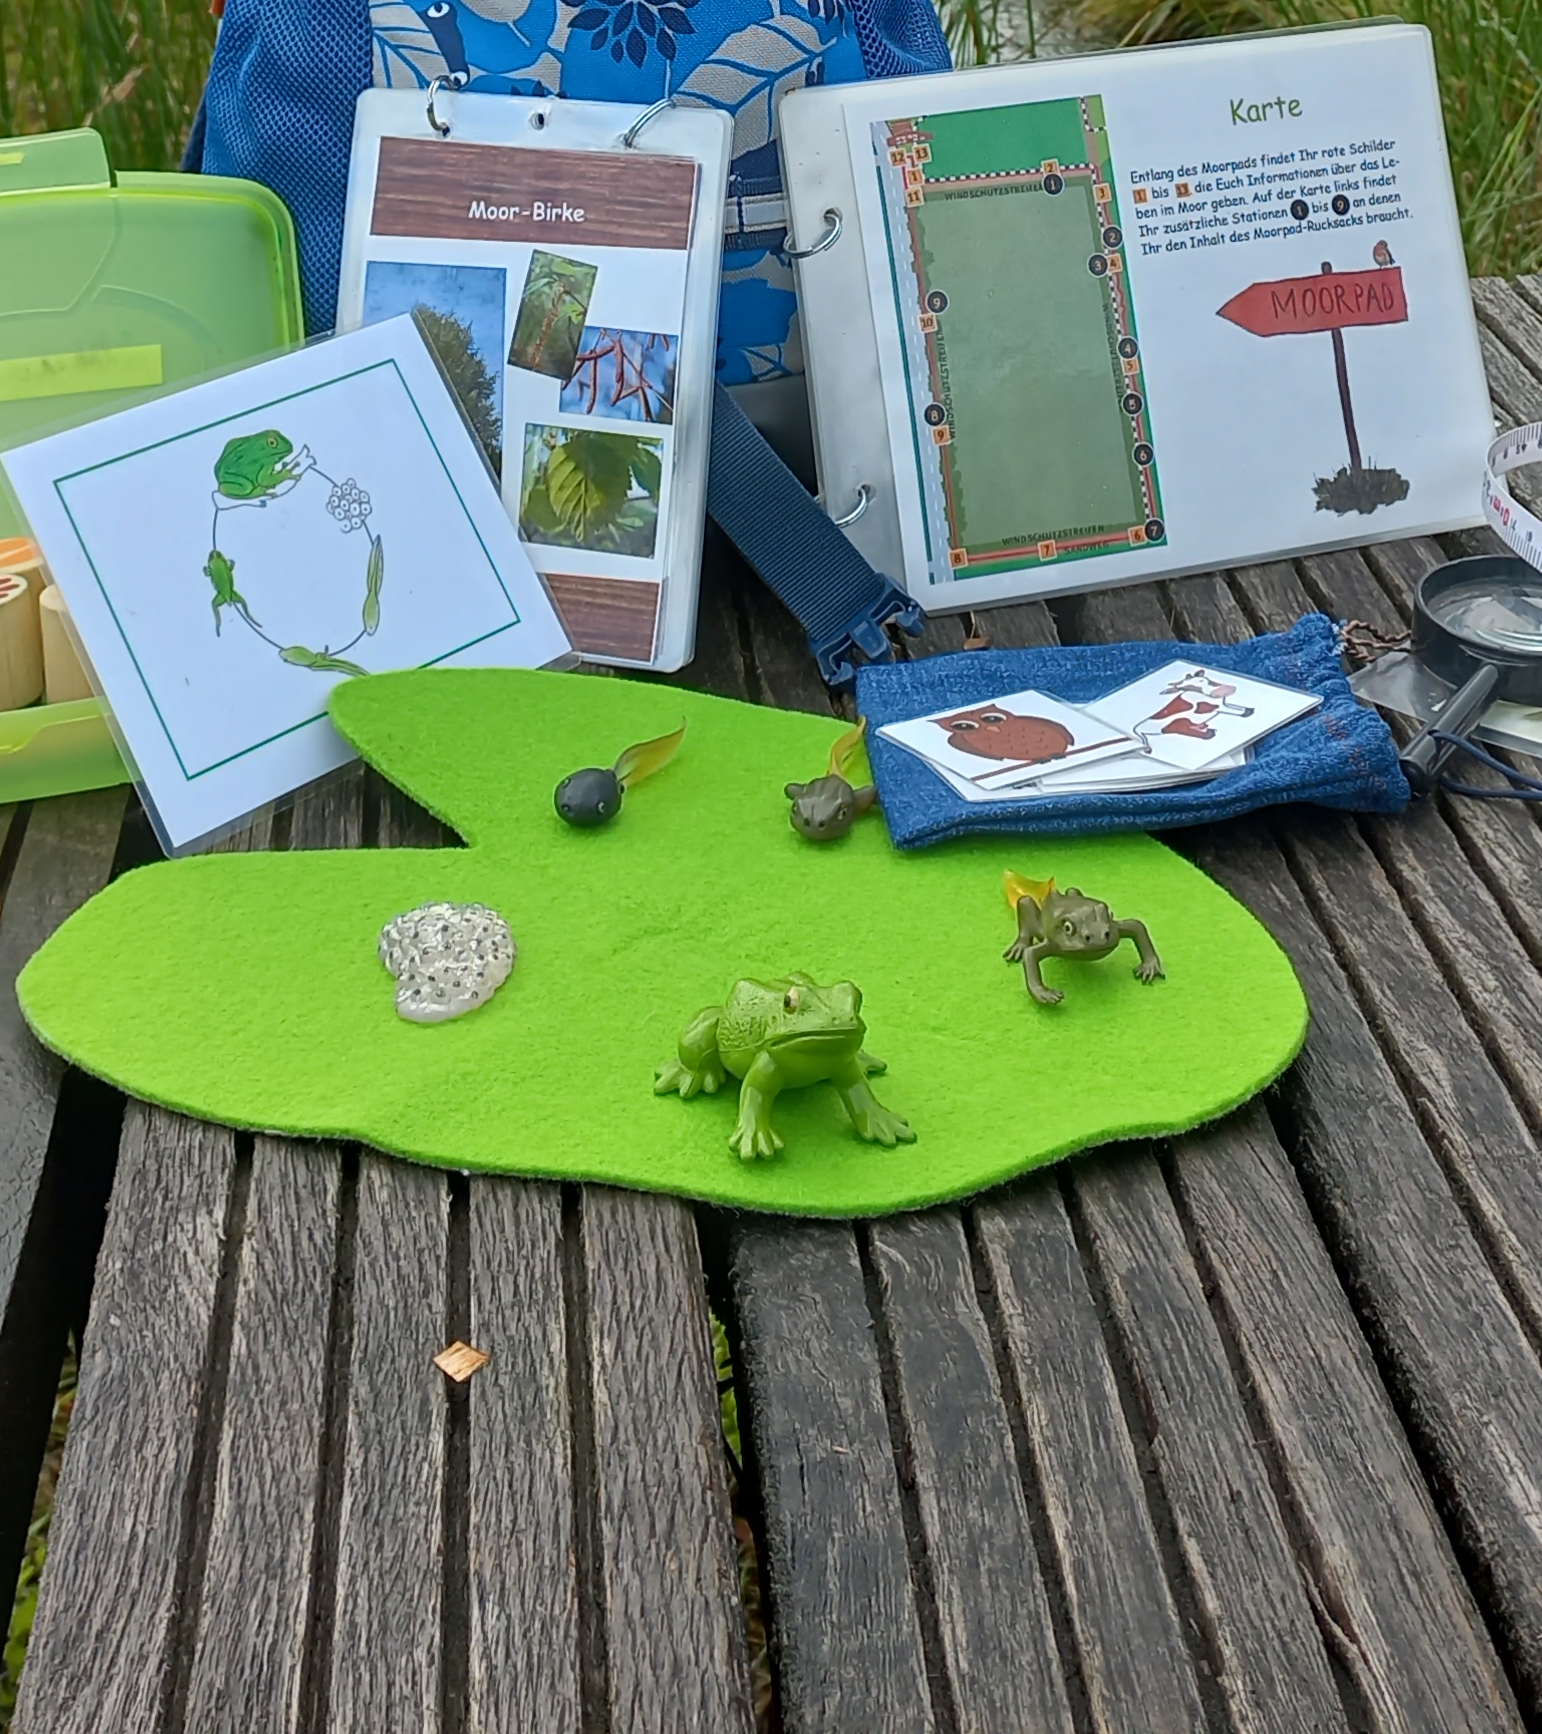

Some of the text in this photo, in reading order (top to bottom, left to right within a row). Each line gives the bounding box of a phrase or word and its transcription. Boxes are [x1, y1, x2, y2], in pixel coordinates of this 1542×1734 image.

[1229, 96, 1303, 126] Karte
[891, 151, 905, 163] 12
[915, 147, 928, 159] 13
[1130, 138, 1395, 184] Entlang des Moorpads findet Ihr rote Schilder
[1151, 186, 1169, 199] bis
[1195, 180, 1213, 193] die
[1216, 175, 1244, 190] Euch
[1247, 166, 1328, 186] Informationen
[1331, 162, 1356, 176] über
[1360, 158, 1379, 171] das
[1381, 156, 1400, 168] Le-
[907, 190, 920, 203] 11
[1135, 207, 1157, 219] ben
[1160, 204, 1174, 216] im
[1178, 201, 1207, 214] Moor
[1252, 191, 1272, 204] Auf
[1277, 187, 1297, 200] der
[1299, 185, 1331, 198] Karte
[1335, 179, 1359, 192] links
[1363, 174, 1397, 188] findet
[468, 200, 586, 222] Moor-Birke
[1139, 225, 1159, 237] Ihr
[1163, 216, 1229, 234] zusätzliche
[1233, 207, 1288, 224] Stationen
[1311, 201, 1329, 213] bis
[1353, 198, 1366, 208] an
[1369, 192, 1401, 206] denen
[1109, 232, 1117, 242] 2
[1141, 208, 1413, 255] Ihr den Inhalt des Moorpad-Rucksacks braucht.
[1094, 260, 1102, 270] 3
[1271, 282, 1395, 319] MOORPAD
[921, 317, 933, 328] 10
[1124, 343, 1132, 354] 4
[1129, 399, 1136, 410] 5
[1139, 450, 1147, 461] 6
[1150, 525, 1158, 536] 7
